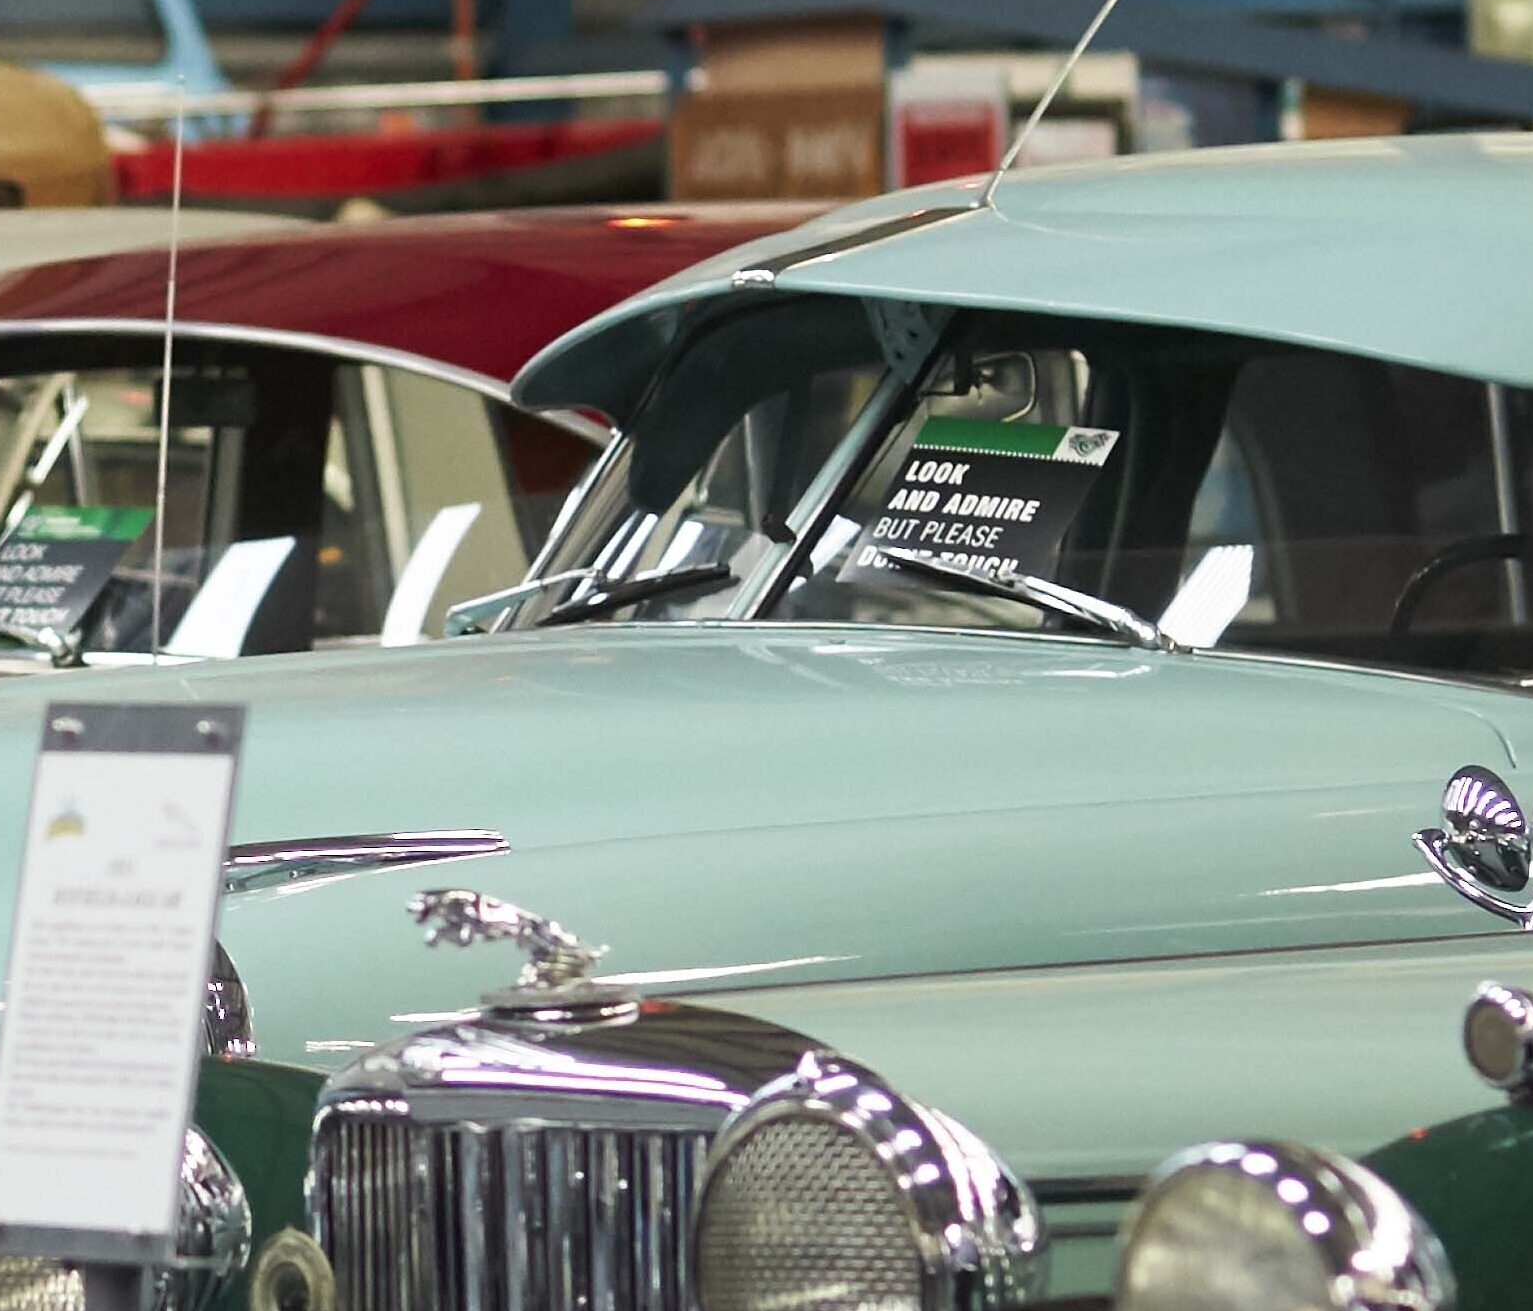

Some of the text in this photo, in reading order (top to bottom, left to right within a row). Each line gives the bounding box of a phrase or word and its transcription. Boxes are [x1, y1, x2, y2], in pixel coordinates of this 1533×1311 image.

[905, 460, 970, 485] LOOK
[887, 488, 1040, 522] AND ADMIRE
[873, 516, 1003, 549] BUT PLEASE
[0, 543, 48, 561] LOOK
[23, 564, 84, 584] ADMIRE
